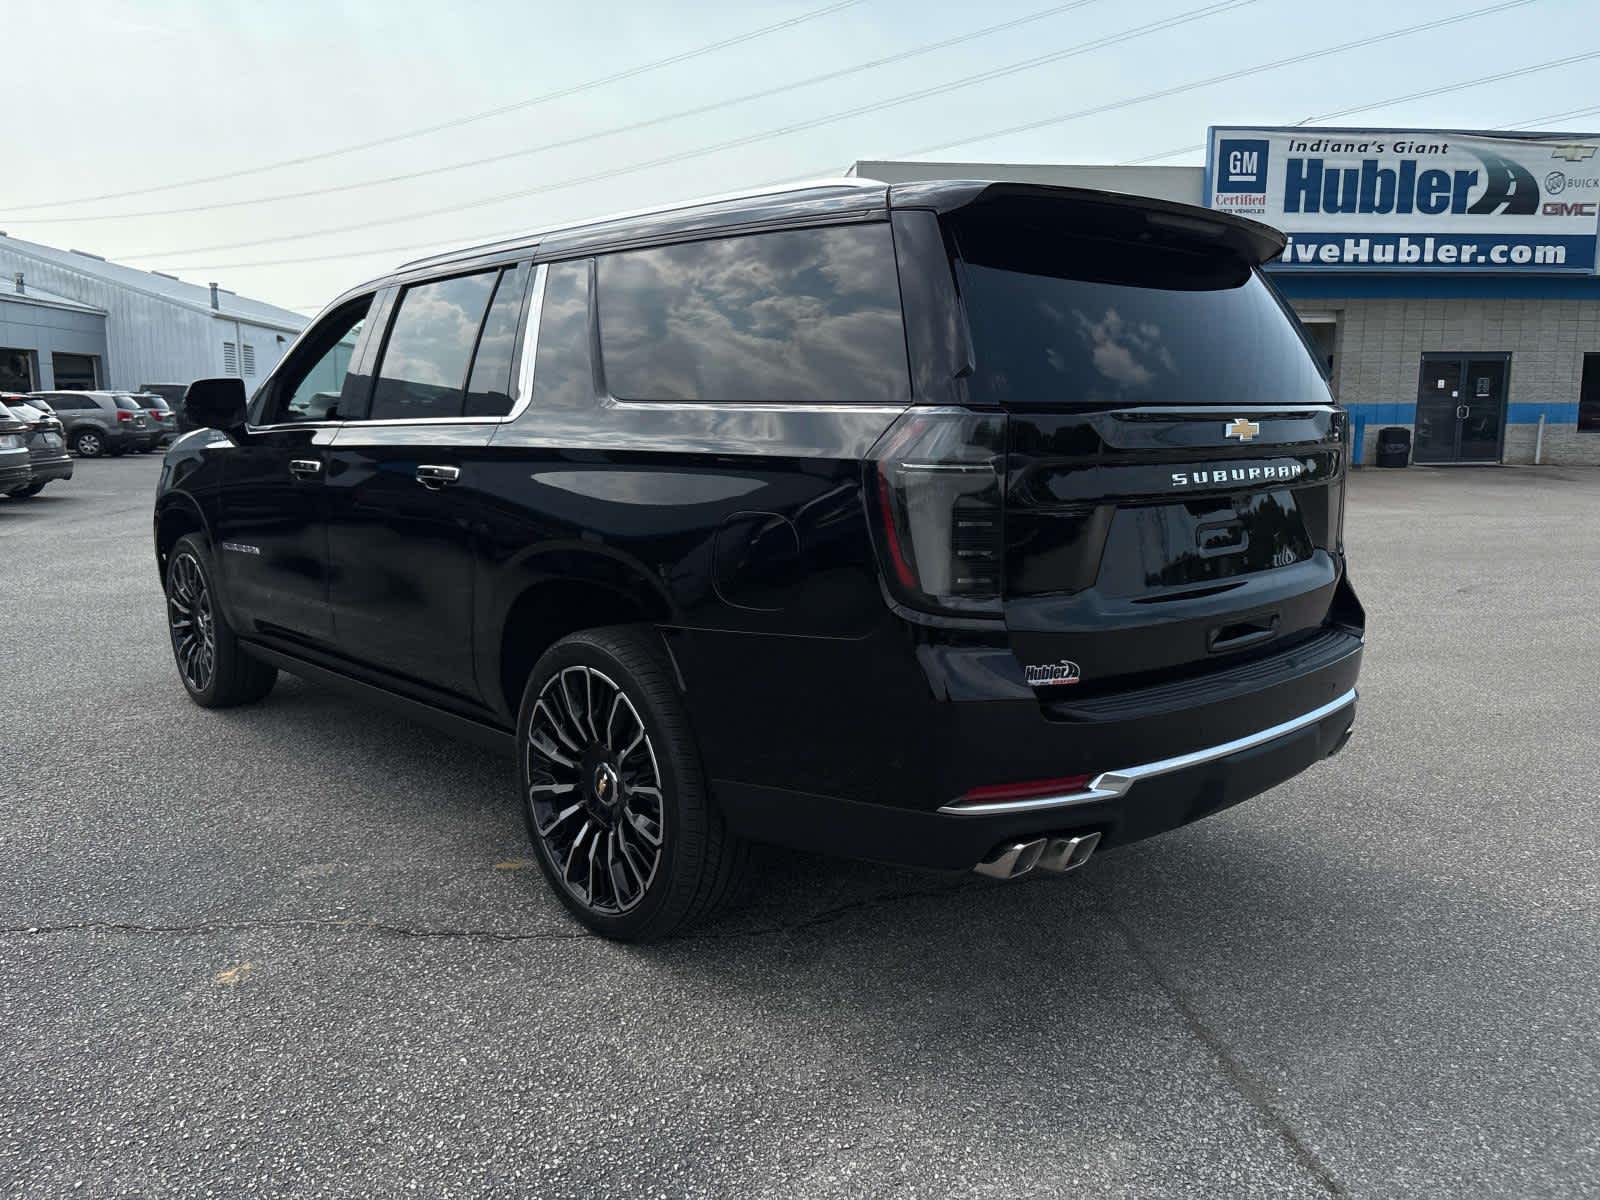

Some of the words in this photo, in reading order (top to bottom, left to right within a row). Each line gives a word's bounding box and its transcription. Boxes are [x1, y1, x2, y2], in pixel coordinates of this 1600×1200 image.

[1288, 140, 1385, 153] Indiana's
[1392, 141, 1449, 155] Giant
[1229, 151, 1258, 174] GM
[1284, 158, 1479, 215] Hubler
[1567, 178, 1600, 188] BUICK
[1216, 194, 1266, 206] Certified
[1543, 203, 1597, 217] GMC
[1282, 236, 1566, 264] iveHubler.com
[1171, 464, 1301, 487] SUBURBAN
[1024, 664, 1068, 681] Hubler
